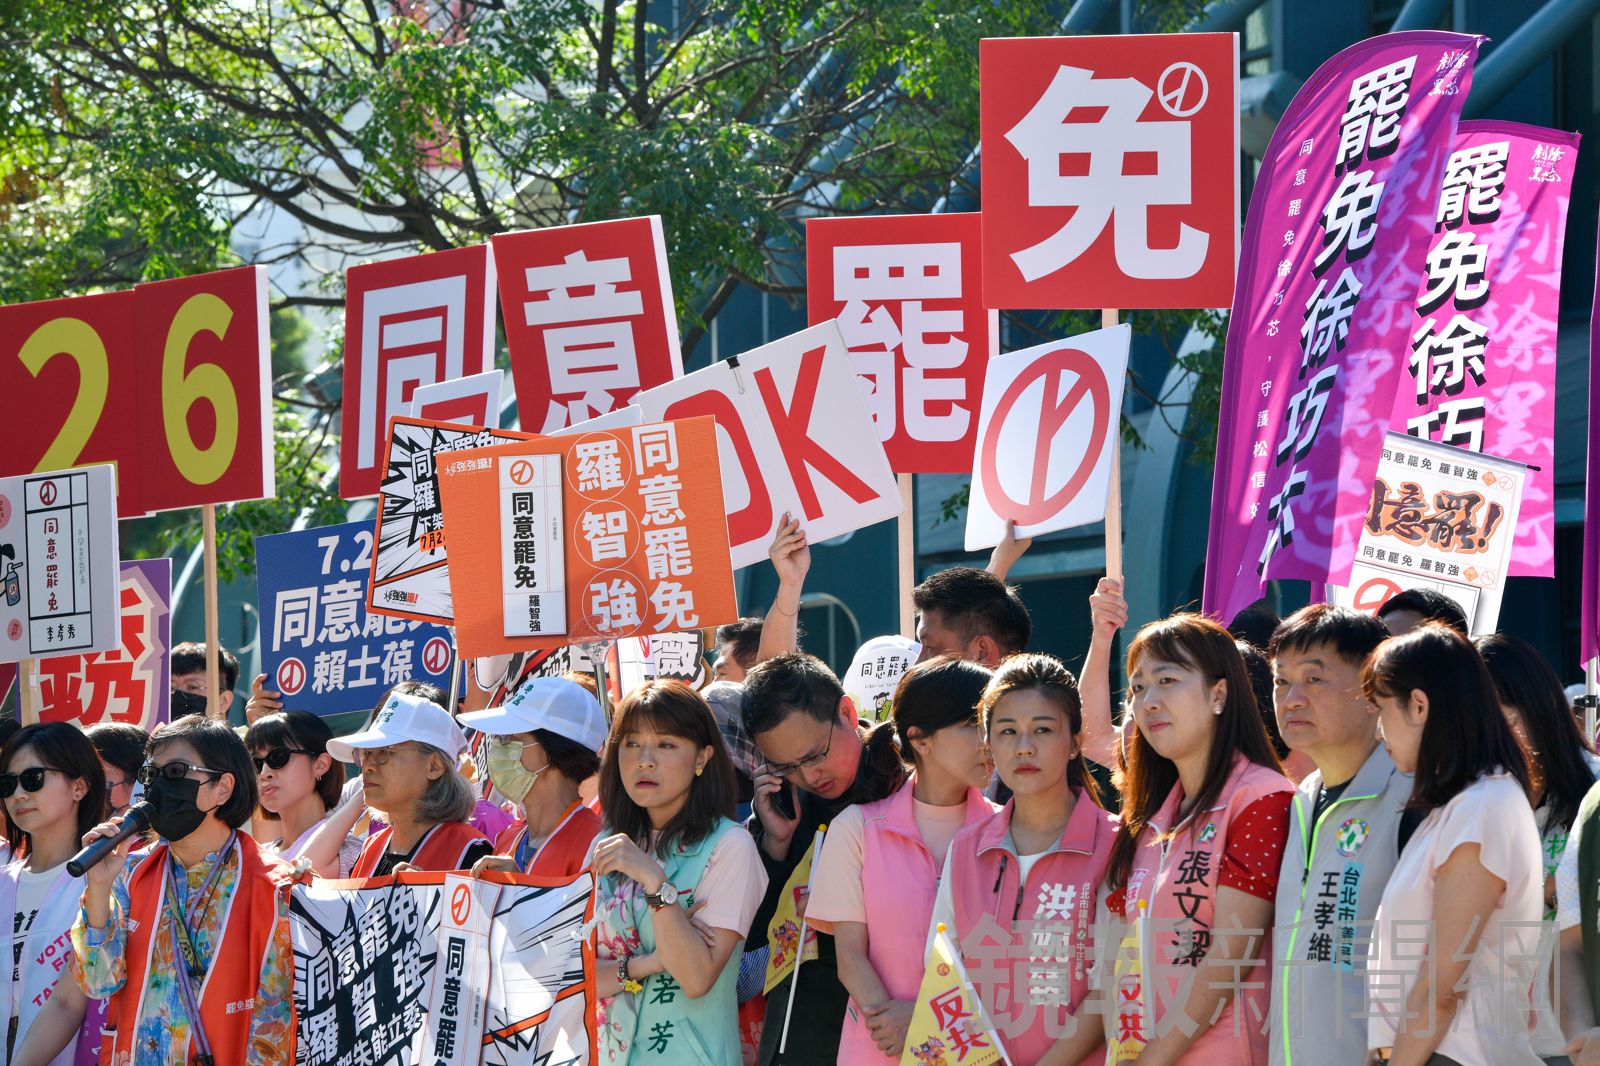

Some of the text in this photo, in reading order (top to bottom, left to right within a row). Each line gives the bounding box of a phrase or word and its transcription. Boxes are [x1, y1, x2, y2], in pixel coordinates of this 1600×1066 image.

[1003, 65, 1210, 282] 免
[357, 274, 466, 470] 同
[523, 249, 644, 435] 意
[832, 242, 971, 442] 罷
[1381, 449, 1479, 481] 同意罷免 羅智強
[44, 517, 59, 612] 同意罷免
[318, 531, 375, 575] 7.2
[421, 532, 445, 549] 7月2
[512, 491, 537, 589] 同意罷免
[575, 439, 642, 633] 羅智強
[631, 421, 699, 632] 同意罷免
[1363, 545, 1460, 577] 同意罷免 羅智強
[47, 623, 76, 643] 李彥秀
[529, 595, 541, 632] 羅智強
[312, 639, 415, 694] 賴士葆
[306, 886, 419, 1011] 同意罷免
[1172, 850, 1212, 968] 張文潔
[1307, 872, 1340, 962] 王孝維
[930, 986, 990, 1062] 反共
